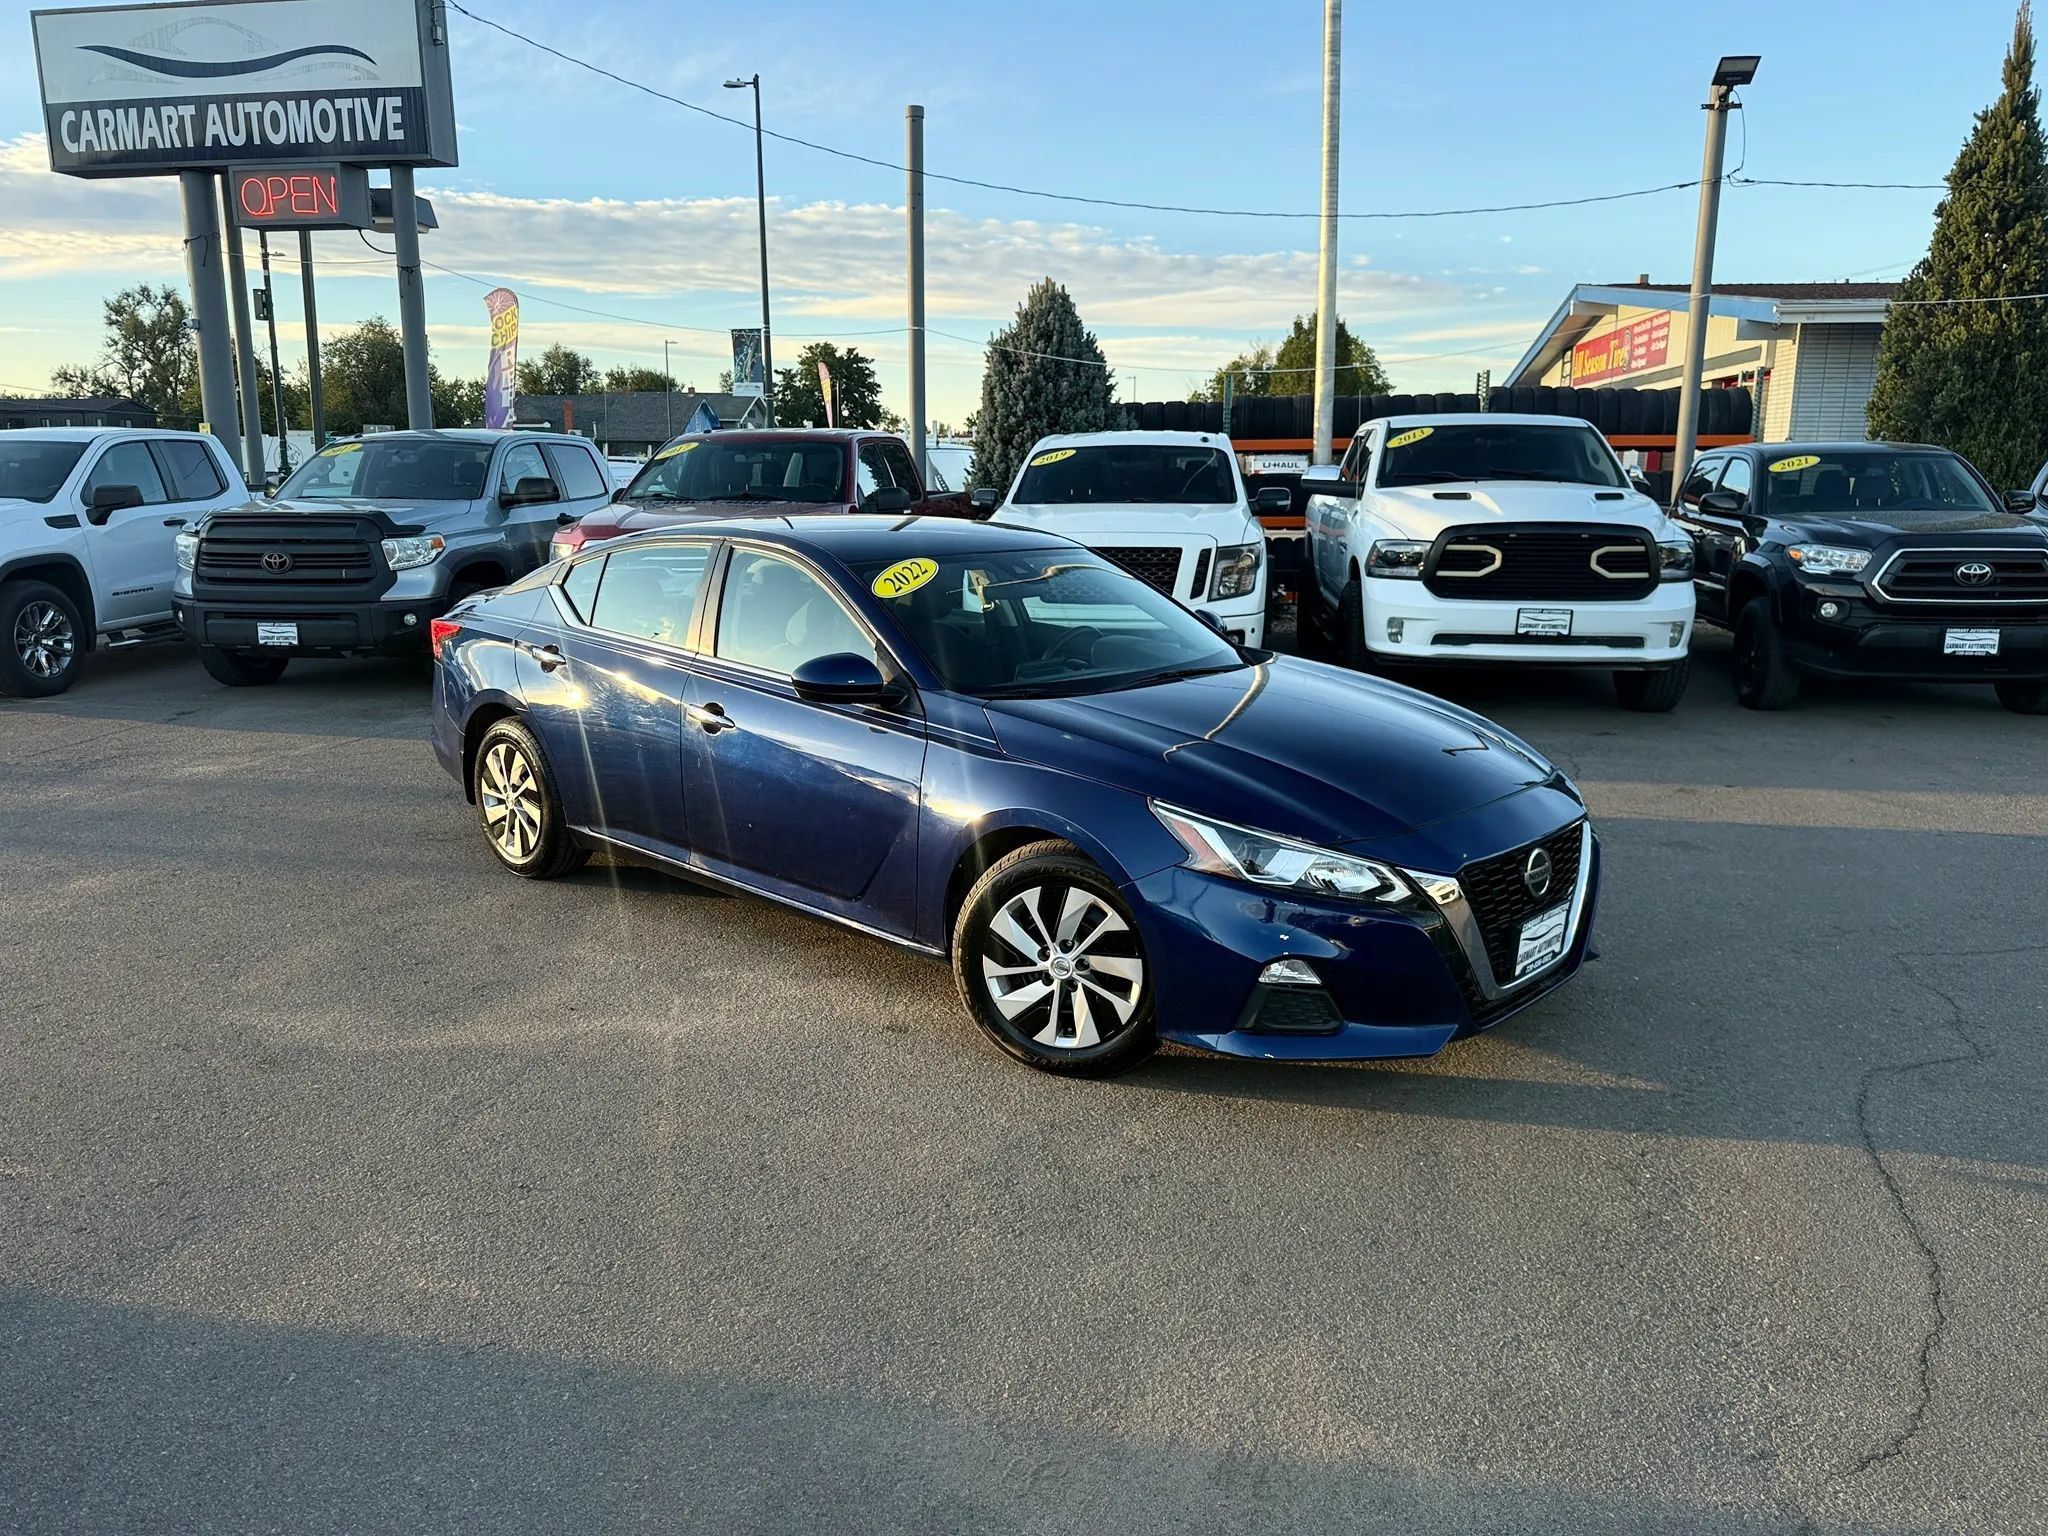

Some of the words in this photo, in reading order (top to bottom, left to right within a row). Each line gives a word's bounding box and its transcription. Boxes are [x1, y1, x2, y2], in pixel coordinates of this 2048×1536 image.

[60, 104, 195, 154] CARMART
[205, 97, 405, 147] AUTOMOTIVE
[241, 175, 337, 216] OPEN
[491, 322, 518, 347] CHIP
[1583, 349, 1609, 376] Season
[1397, 430, 1425, 445] 2013
[1040, 450, 1068, 464] 2019
[1262, 461, 1300, 469] U-HAUL
[1780, 456, 1809, 470] 2021
[883, 561, 929, 593] 2022
[111, 586, 154, 597] SIERRA
